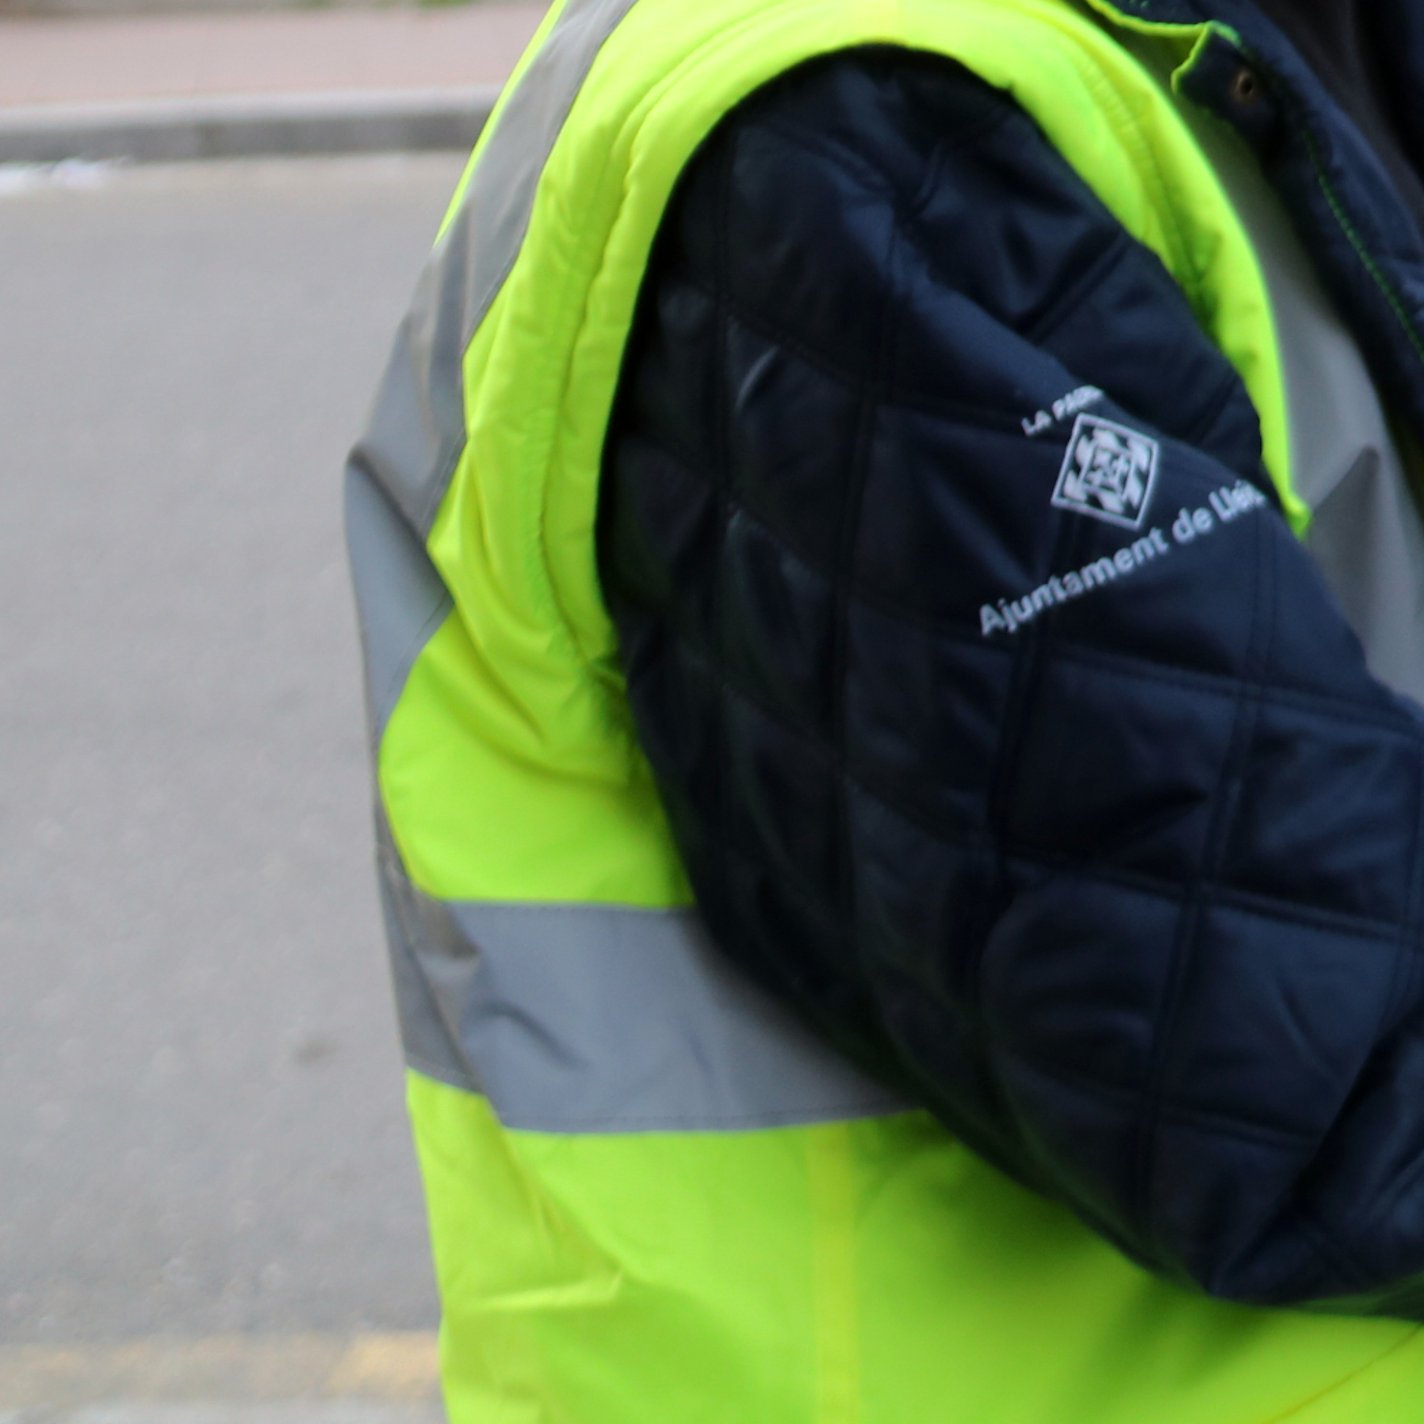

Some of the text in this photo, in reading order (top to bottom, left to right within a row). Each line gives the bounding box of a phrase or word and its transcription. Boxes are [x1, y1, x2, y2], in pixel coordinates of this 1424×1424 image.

[1022, 410, 1052, 436] LA
[979, 527, 1168, 636] Ajuntament
[1173, 506, 1212, 543] de
